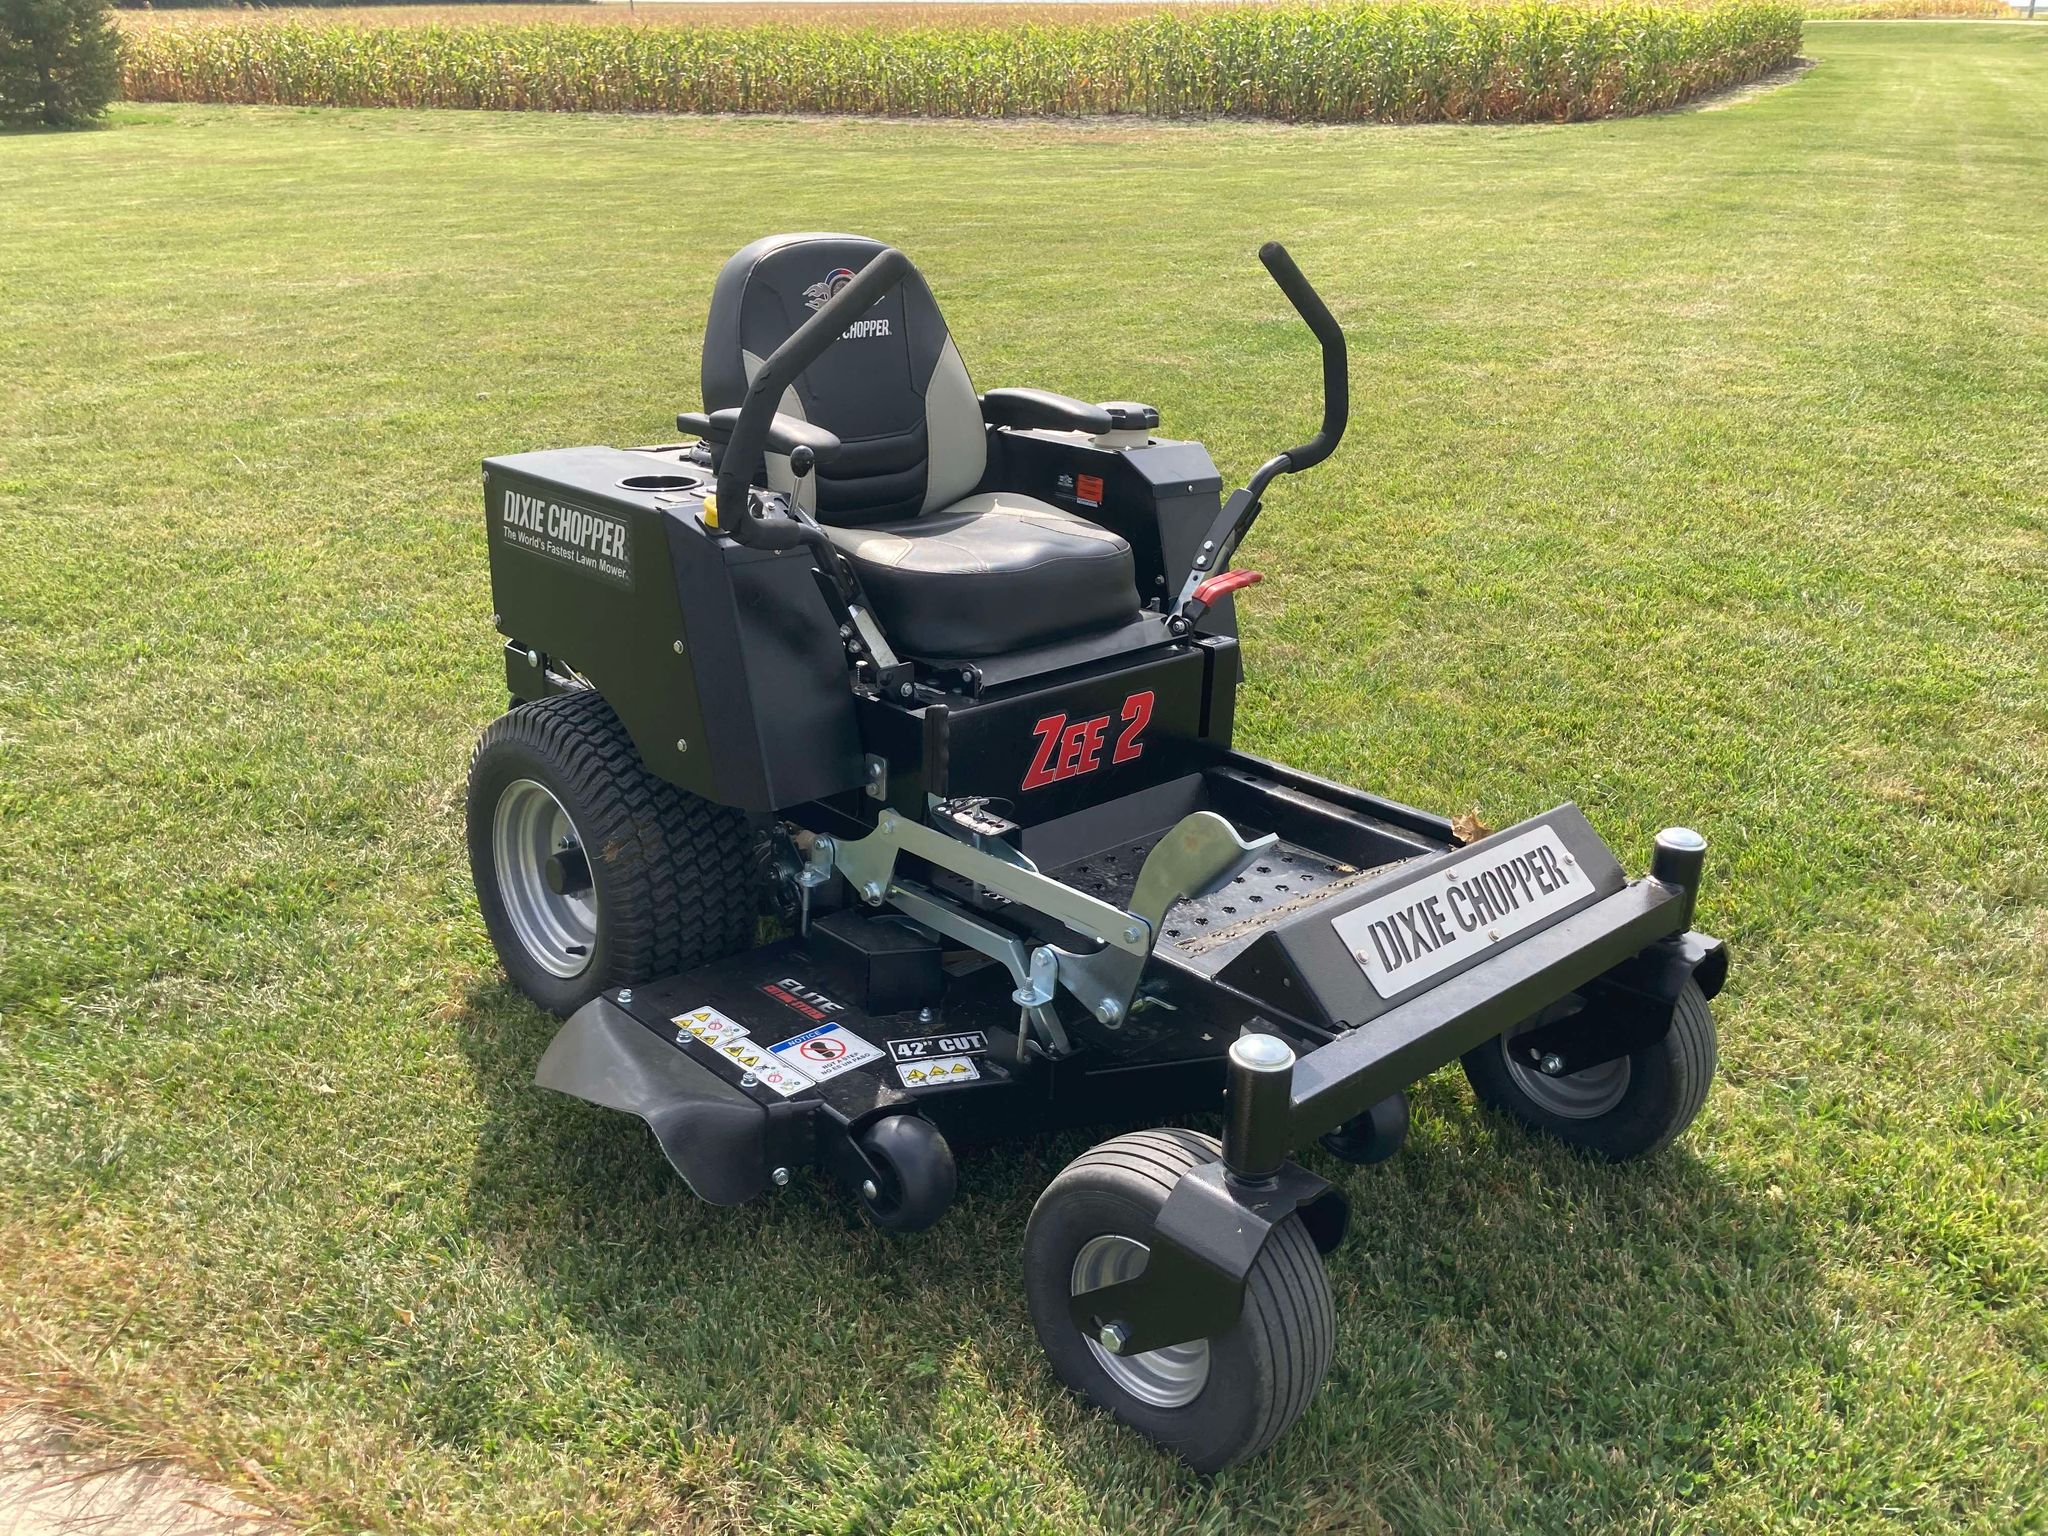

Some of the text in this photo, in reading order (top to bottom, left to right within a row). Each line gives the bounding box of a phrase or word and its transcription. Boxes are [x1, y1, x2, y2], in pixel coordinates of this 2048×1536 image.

[503, 489, 627, 561] DIXIE CHOPPER
[503, 525, 627, 578] The World's Fastest Lawn Mower
[1112, 690, 1155, 765] 2
[1367, 844, 1570, 974] DIXIE CHOPPER
[776, 977, 845, 1014] ELITE
[787, 1029, 822, 1047] NOTICE
[938, 1035, 981, 1052] CUT
[822, 1061, 835, 1069] NOT
[841, 1052, 858, 1062] STEP
[852, 1052, 871, 1063] PASO
